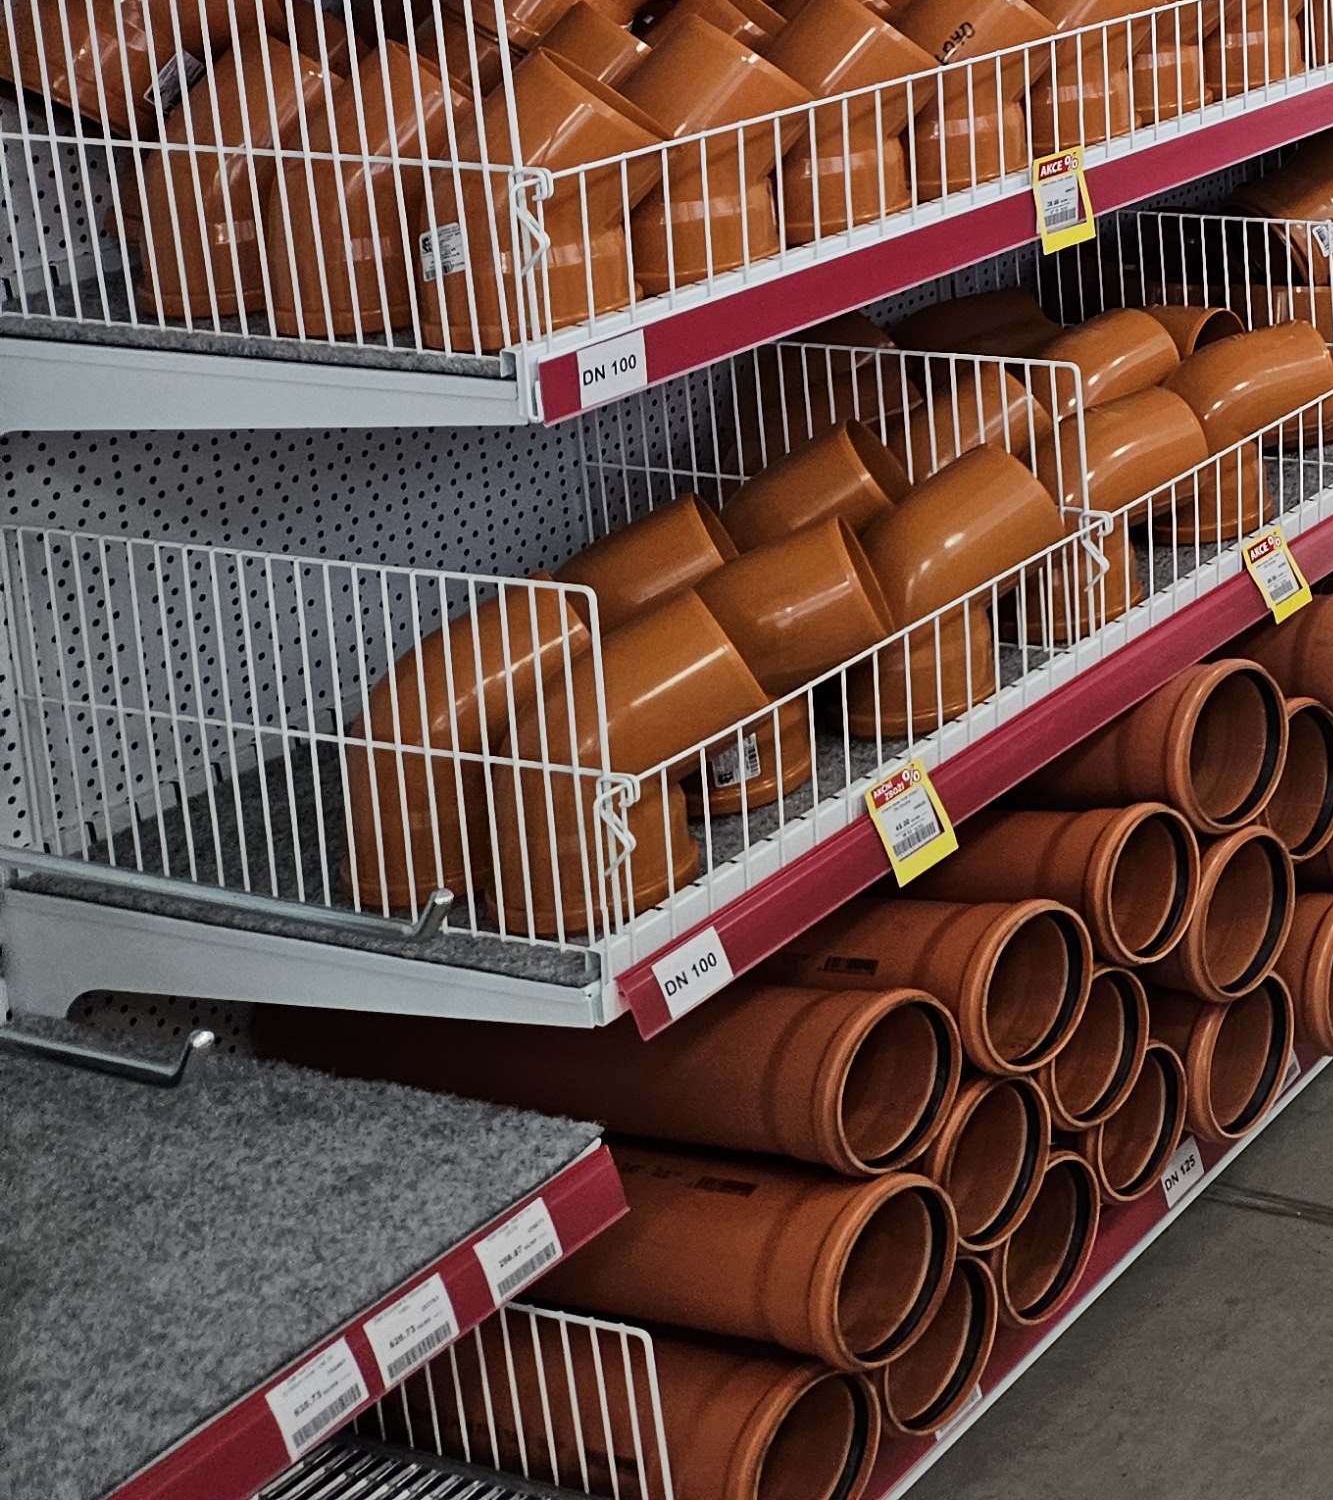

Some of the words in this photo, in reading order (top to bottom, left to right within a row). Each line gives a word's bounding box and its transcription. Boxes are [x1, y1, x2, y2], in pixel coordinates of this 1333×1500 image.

[1040, 159, 1063, 177] AKCE
[1064, 152, 1078, 171] %
[583, 364, 606, 386] DN
[612, 354, 637, 375] 100
[1250, 541, 1269, 561] AKCE
[664, 971, 689, 996] DN
[691, 952, 717, 977] 100
[1164, 1171, 1179, 1192] DN
[1180, 1154, 1196, 1175] 125
